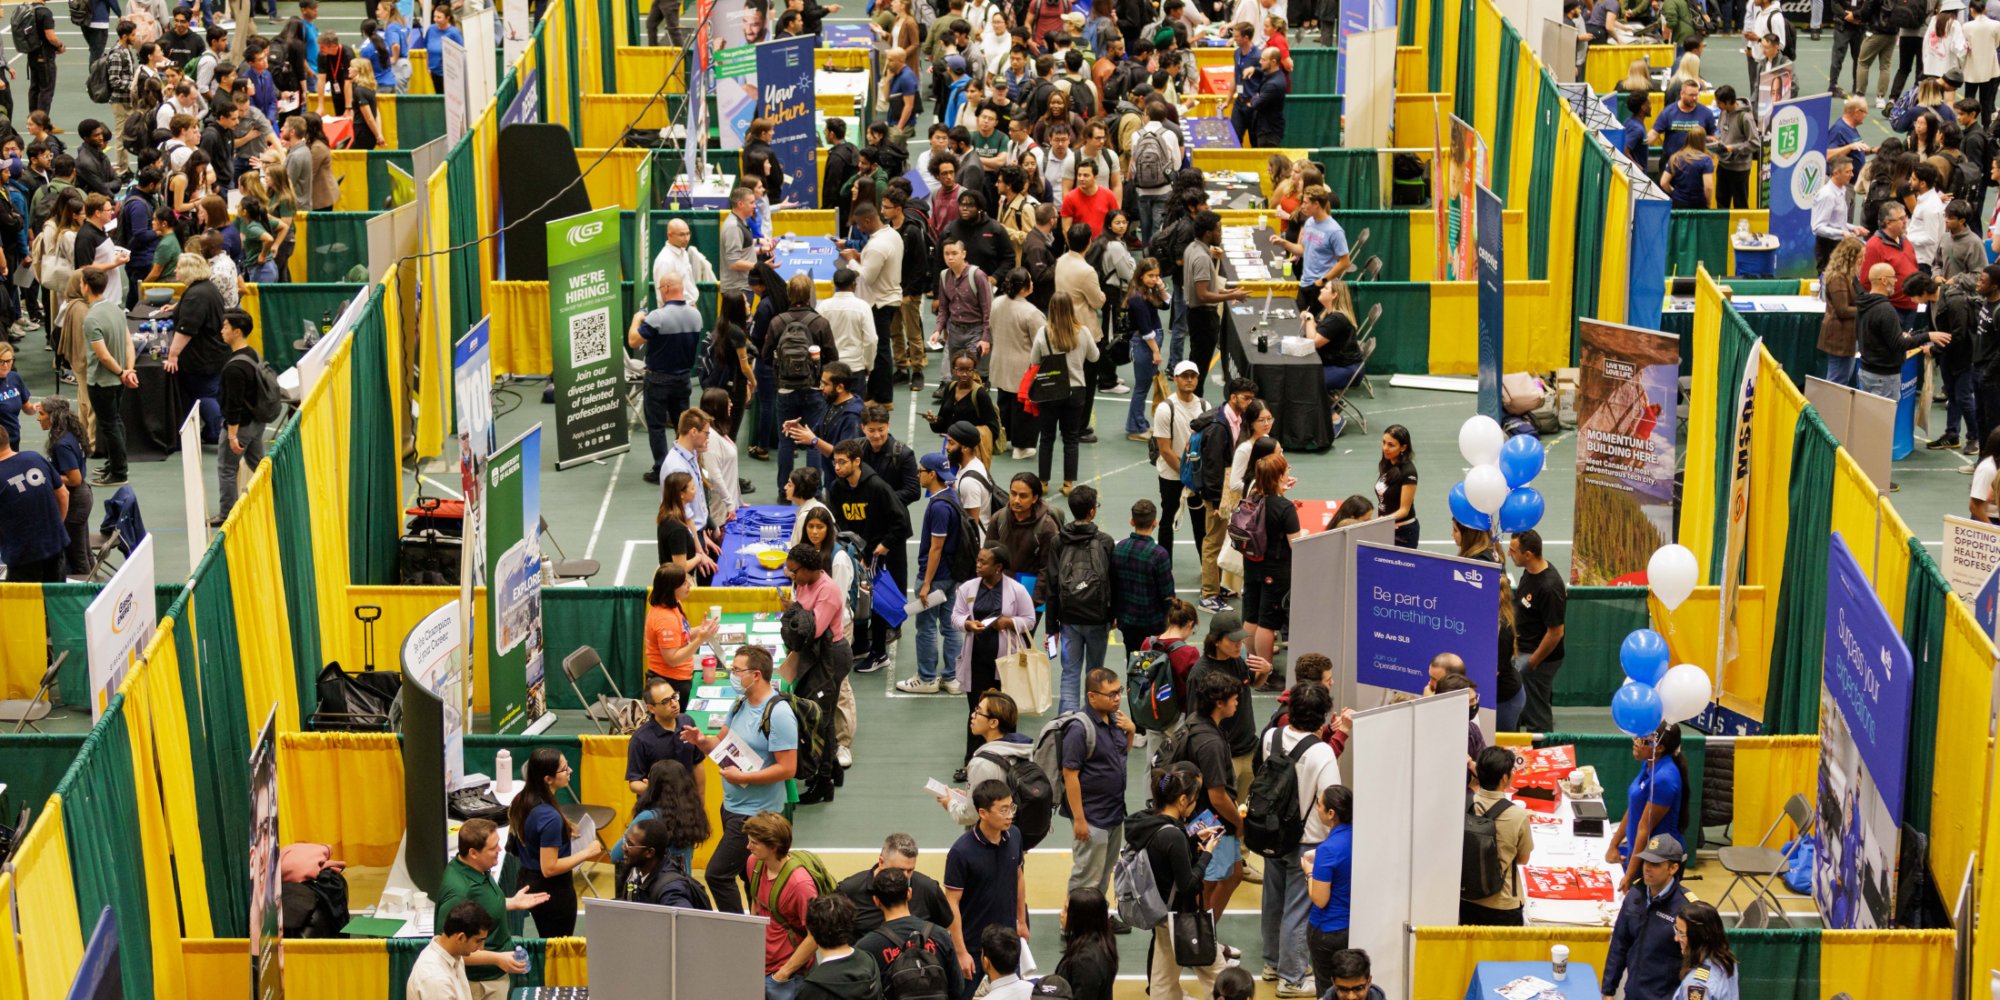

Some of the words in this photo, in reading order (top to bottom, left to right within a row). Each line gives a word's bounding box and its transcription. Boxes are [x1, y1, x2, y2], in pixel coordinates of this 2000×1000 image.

[765, 84, 797, 112] Your
[1778, 116, 1800, 127] Alberta's
[1781, 130, 1795, 149] 75
[1478, 246, 1498, 270] cenovus
[569, 269, 605, 289] WE'RE
[566, 282, 609, 304] HIRING!
[576, 369, 591, 382] Join
[593, 366, 608, 377] our
[1605, 368, 1619, 376] LOVE
[1606, 361, 1618, 370] LIVE
[567, 382, 595, 397] diverse
[597, 376, 617, 388] team
[571, 397, 581, 408] of
[582, 387, 614, 405] talented
[567, 398, 620, 425] professionals!
[572, 430, 586, 440] Apply
[601, 422, 616, 430] G3.ca
[1587, 429, 1644, 449] MOMENTUM
[1645, 440, 1655, 451] IS
[1587, 441, 1632, 459] BUILDING
[1632, 450, 1660, 465] HERE.
[500, 454, 520, 474] UNIVERSITY
[505, 462, 520, 479] ALBERTA
[1586, 457, 1603, 466] Meet
[1603, 461, 1633, 472] Canada's
[1634, 466, 1650, 475] most
[7, 467, 46, 493] TQ
[1584, 477, 1634, 492] livetechlovelife.com
[1585, 465, 1626, 478] adventurous
[1627, 472, 1642, 482] tech
[1643, 475, 1657, 486] city.
[842, 502, 869, 521] CAT
[1954, 526, 1997, 544] EXCITING
[1374, 557, 1416, 568] careers.slb.com
[1954, 546, 1988, 562] HEALTH
[1953, 556, 1993, 573] PROFESS
[1465, 569, 1483, 582] slb
[513, 571, 541, 601] EXPLORE
[118, 590, 134, 613] GIBSON
[1373, 586, 1391, 601] Be
[1394, 593, 1421, 607] part
[1423, 597, 1437, 610] of
[117, 601, 132, 625] ENERGY
[1373, 606, 1441, 631] something
[1444, 615, 1467, 635] big.
[425, 617, 452, 641] Champion
[1373, 631, 1384, 639] We
[1385, 633, 1397, 641] Are
[1397, 635, 1411, 644] SLB
[421, 645, 431, 662] your
[431, 632, 449, 650] Career
[1373, 653, 1386, 661] Join
[1838, 607, 1864, 677] Surpass
[1863, 660, 1880, 704] your
[1373, 661, 1406, 673] Operations
[1406, 667, 1423, 676] team.
